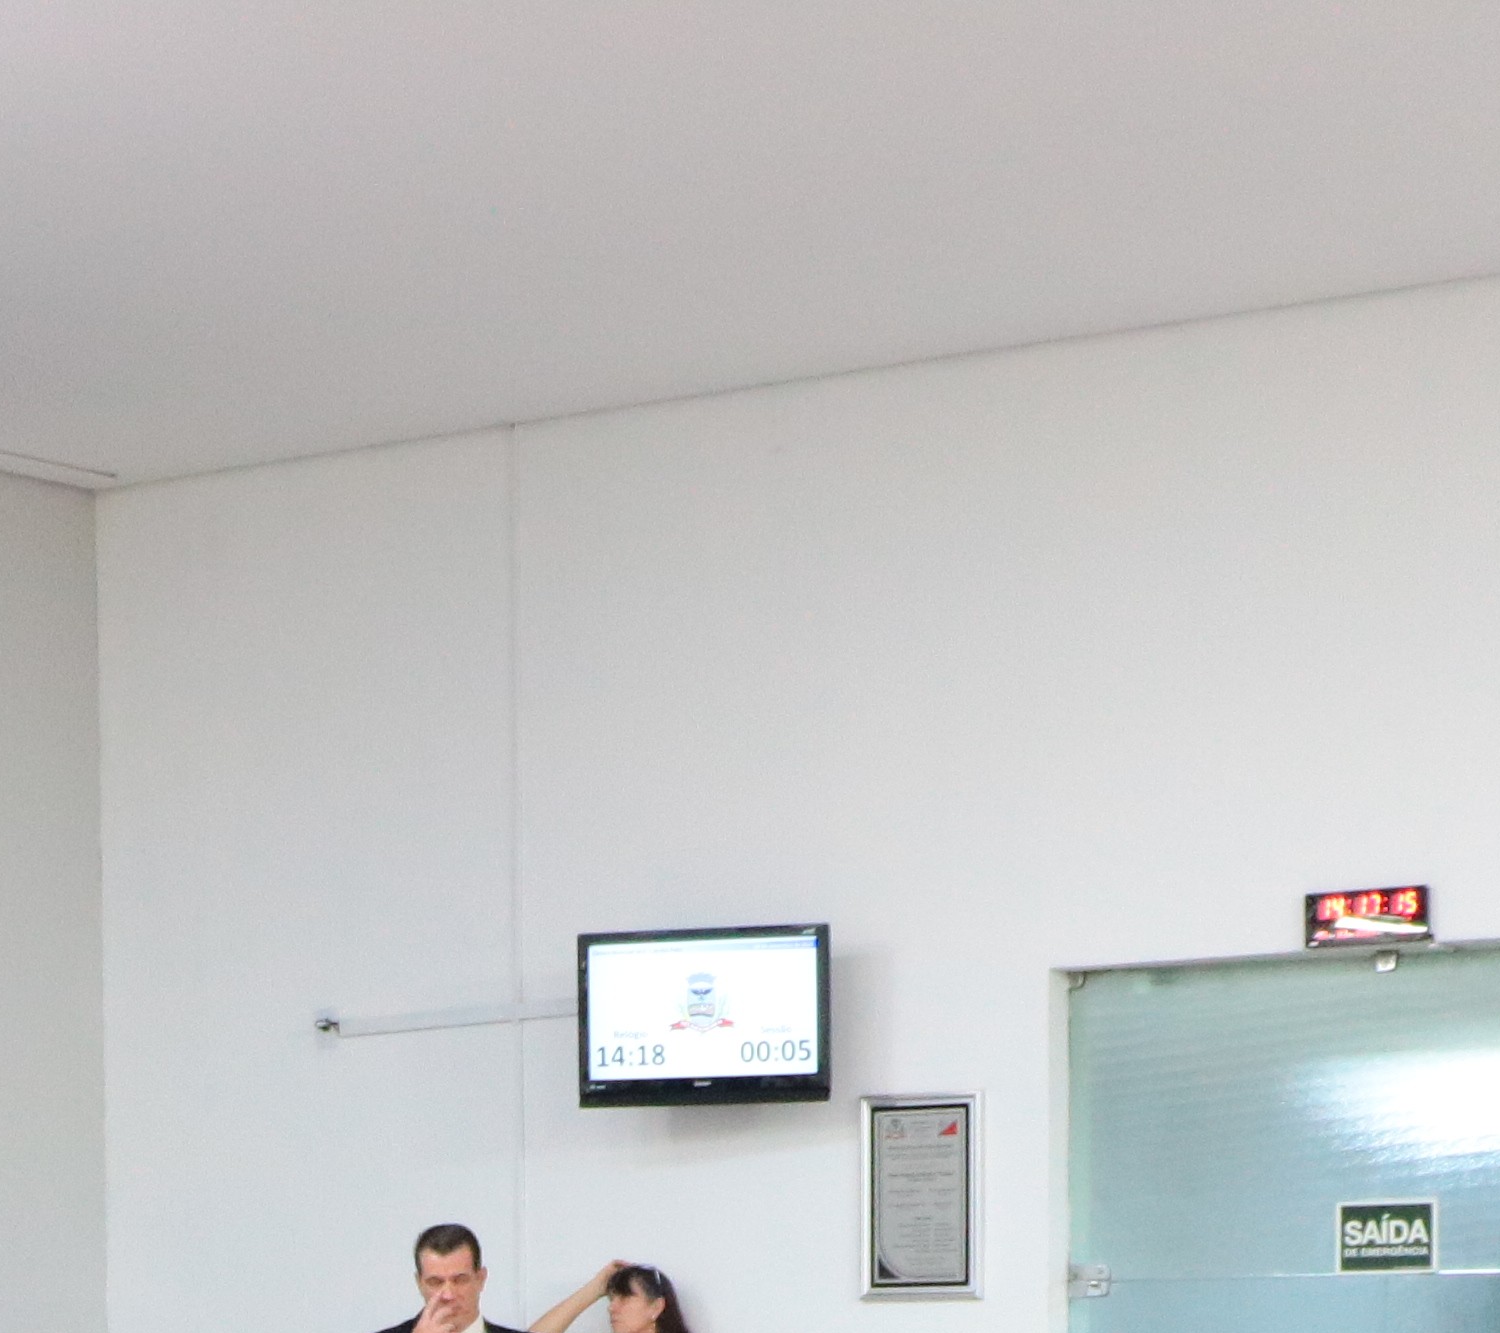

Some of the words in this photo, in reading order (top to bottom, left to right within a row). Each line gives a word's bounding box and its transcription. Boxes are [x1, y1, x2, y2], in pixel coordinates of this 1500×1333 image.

[1317, 890, 1418, 920] 14:17:15
[597, 1045, 665, 1067] 14:18
[741, 1040, 812, 1062] 00:05
[1344, 1213, 1429, 1246] SAÍDA
